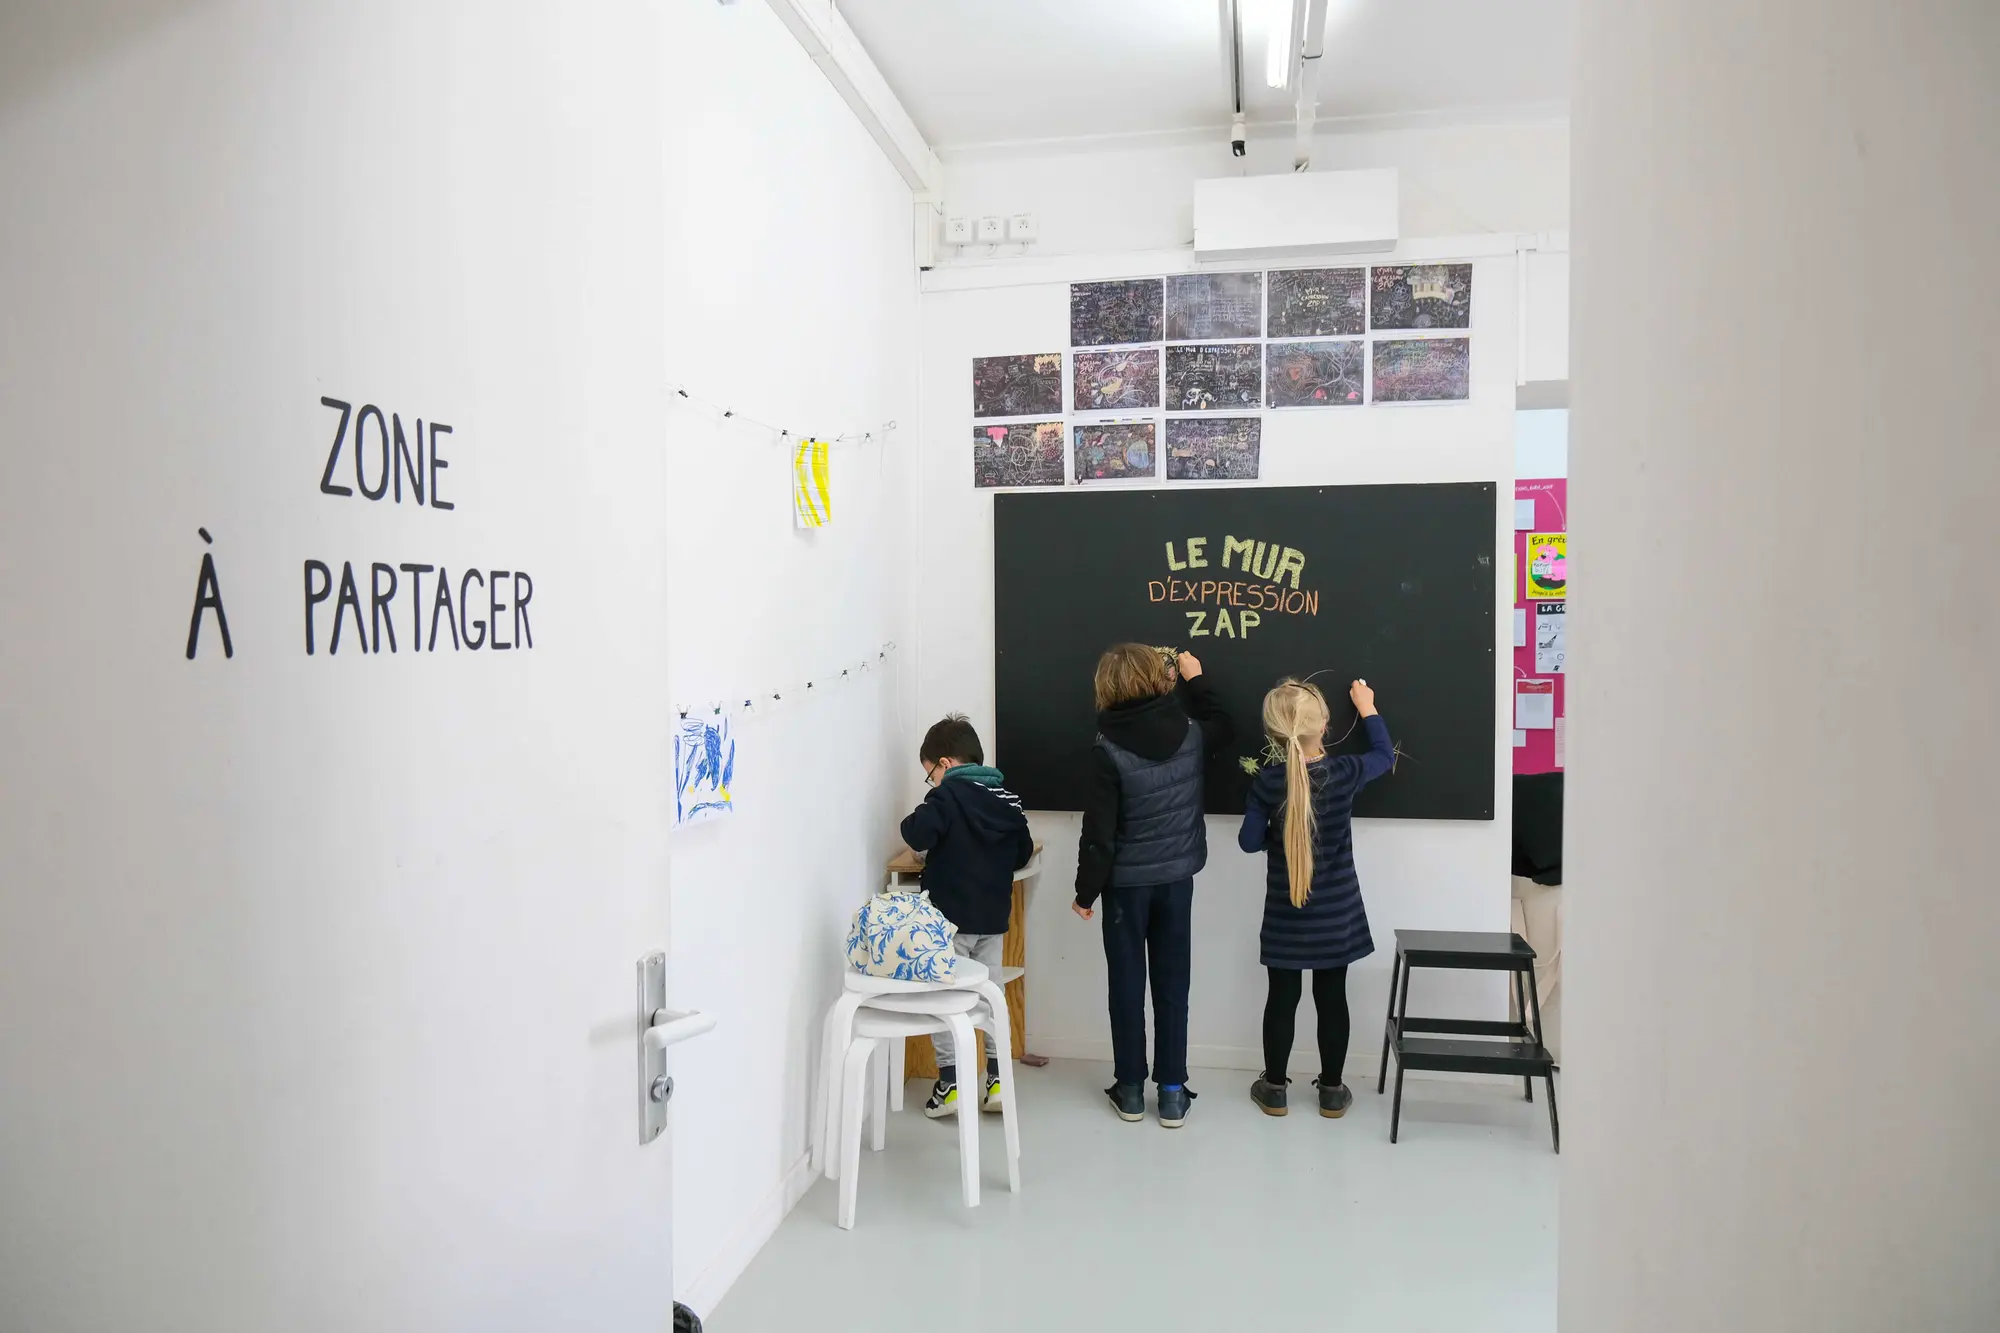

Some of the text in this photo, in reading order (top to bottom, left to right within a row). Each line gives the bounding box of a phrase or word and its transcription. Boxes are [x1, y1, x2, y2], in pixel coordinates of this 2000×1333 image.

[320, 396, 454, 510] ZONE
[1531, 535, 1544, 546] En
[1165, 534, 1306, 590] LE MUR
[186, 527, 533, 660] À PARTAGER
[1148, 575, 1319, 617] D'EXPRESSION
[1541, 604, 1553, 613] LA
[1185, 608, 1261, 639] ZAP
